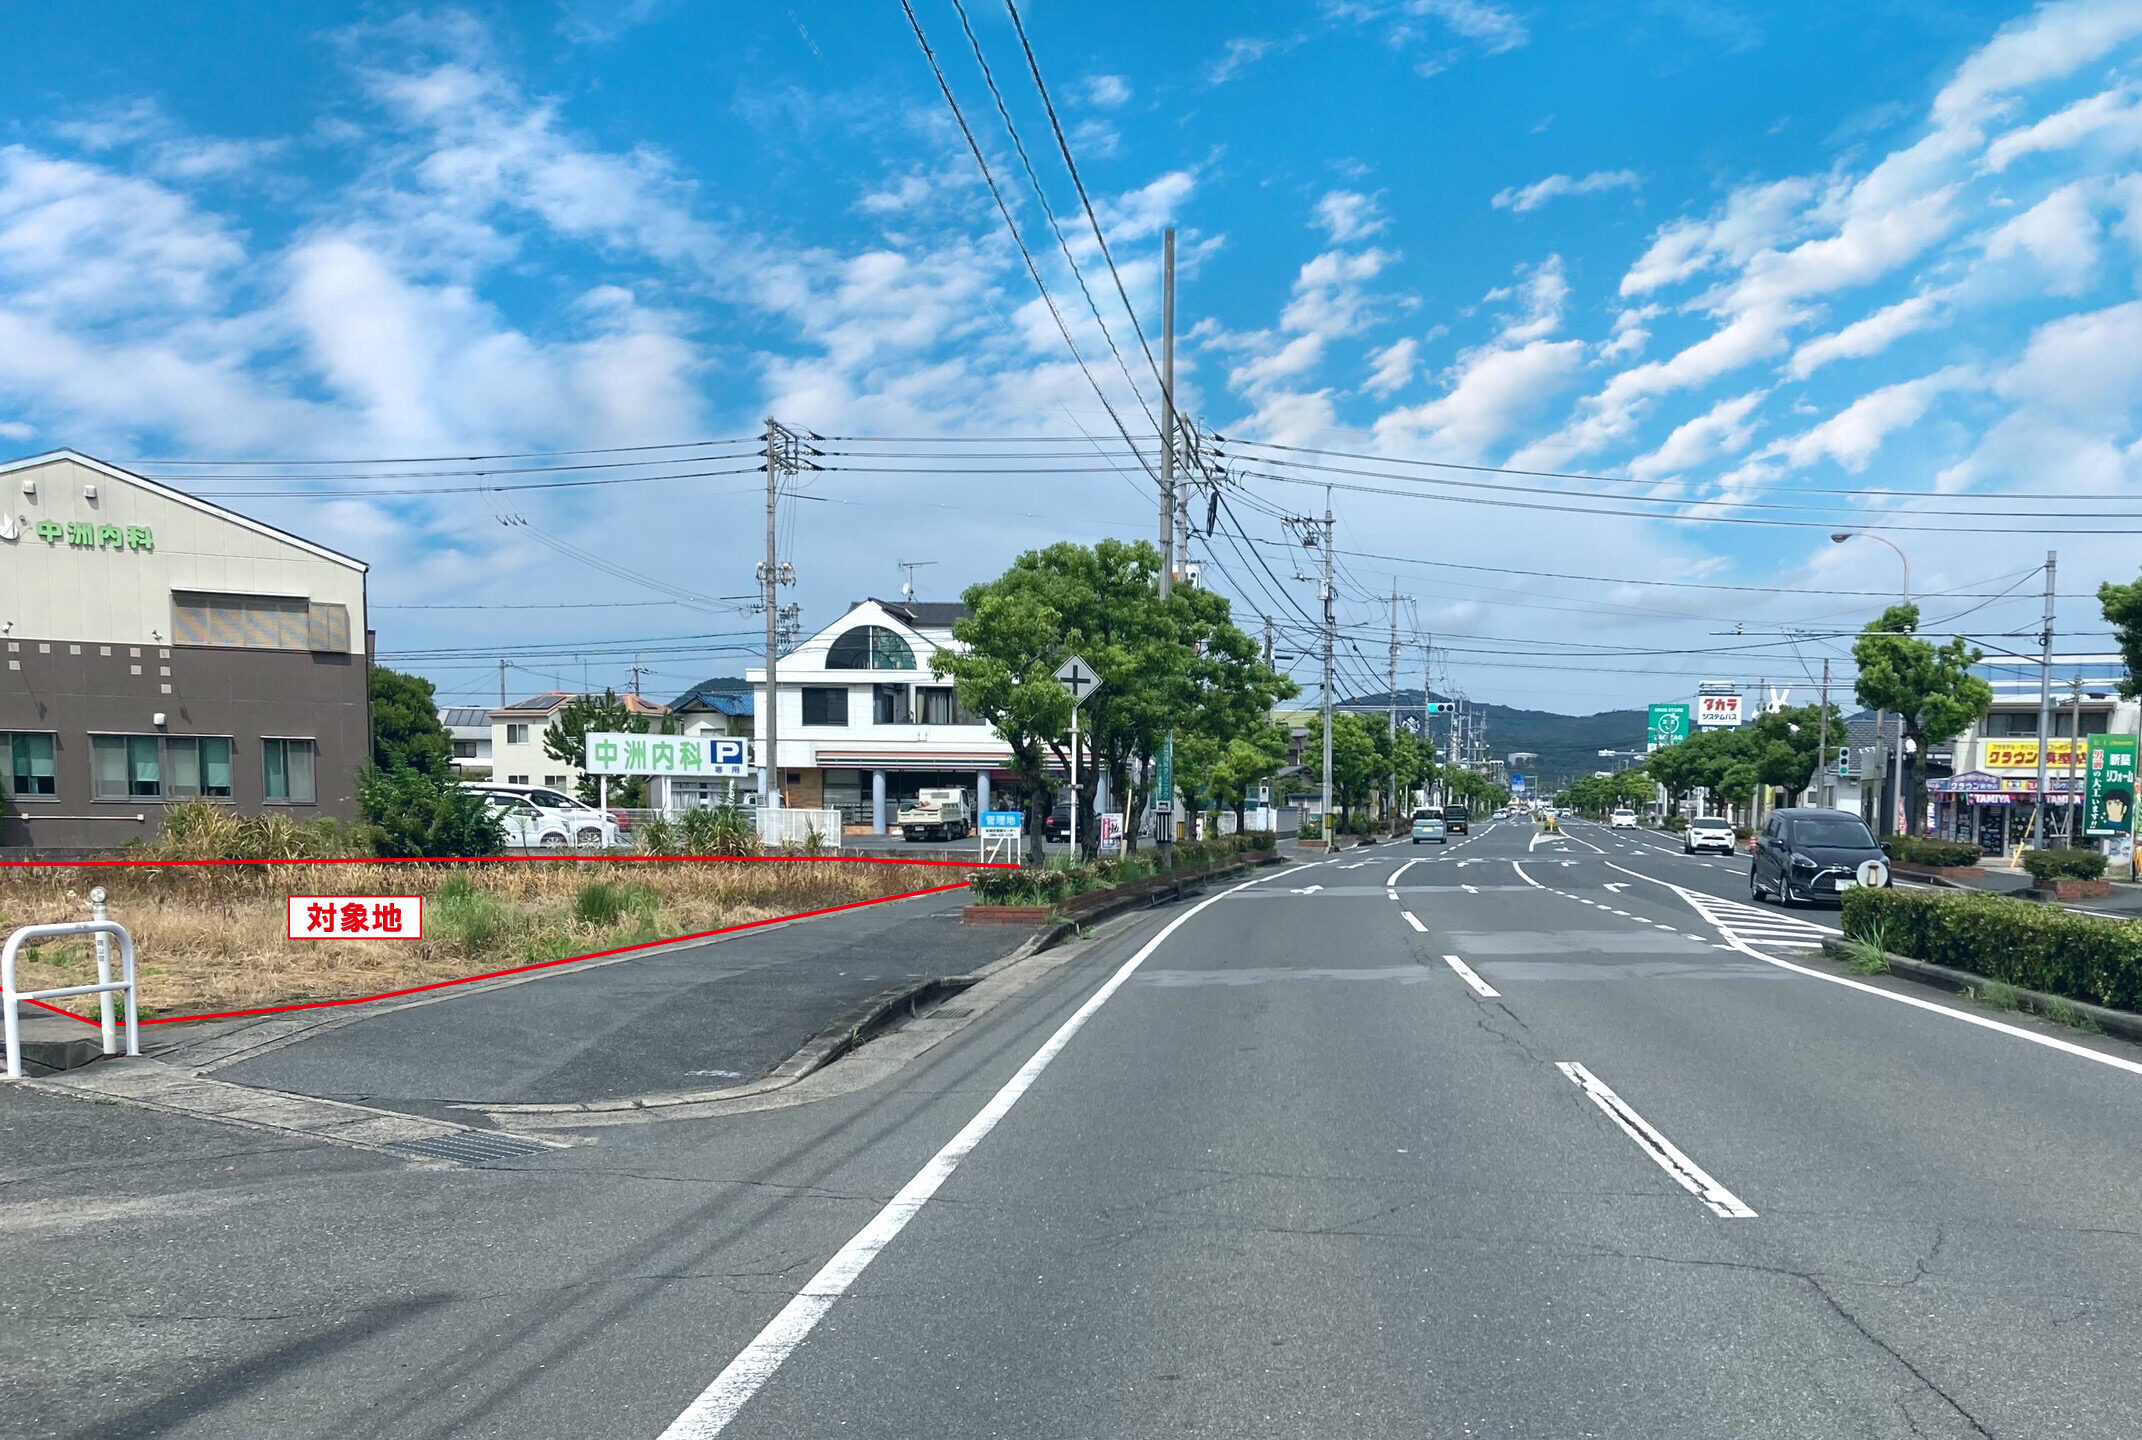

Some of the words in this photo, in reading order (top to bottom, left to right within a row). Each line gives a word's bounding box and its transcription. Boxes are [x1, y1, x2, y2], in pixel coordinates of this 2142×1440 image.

[36, 519, 153, 549] 中洲内科
[1704, 699, 1737, 711] タカラ
[595, 739, 702, 771] 中洲内科
[716, 742, 740, 763] P
[2110, 754, 2131, 766] 新築
[2106, 770, 2133, 783] リフォーム
[1974, 794, 2011, 803] TAMIYA
[2045, 795, 2081, 804] TAMIA
[986, 815, 1016, 825] 管理地
